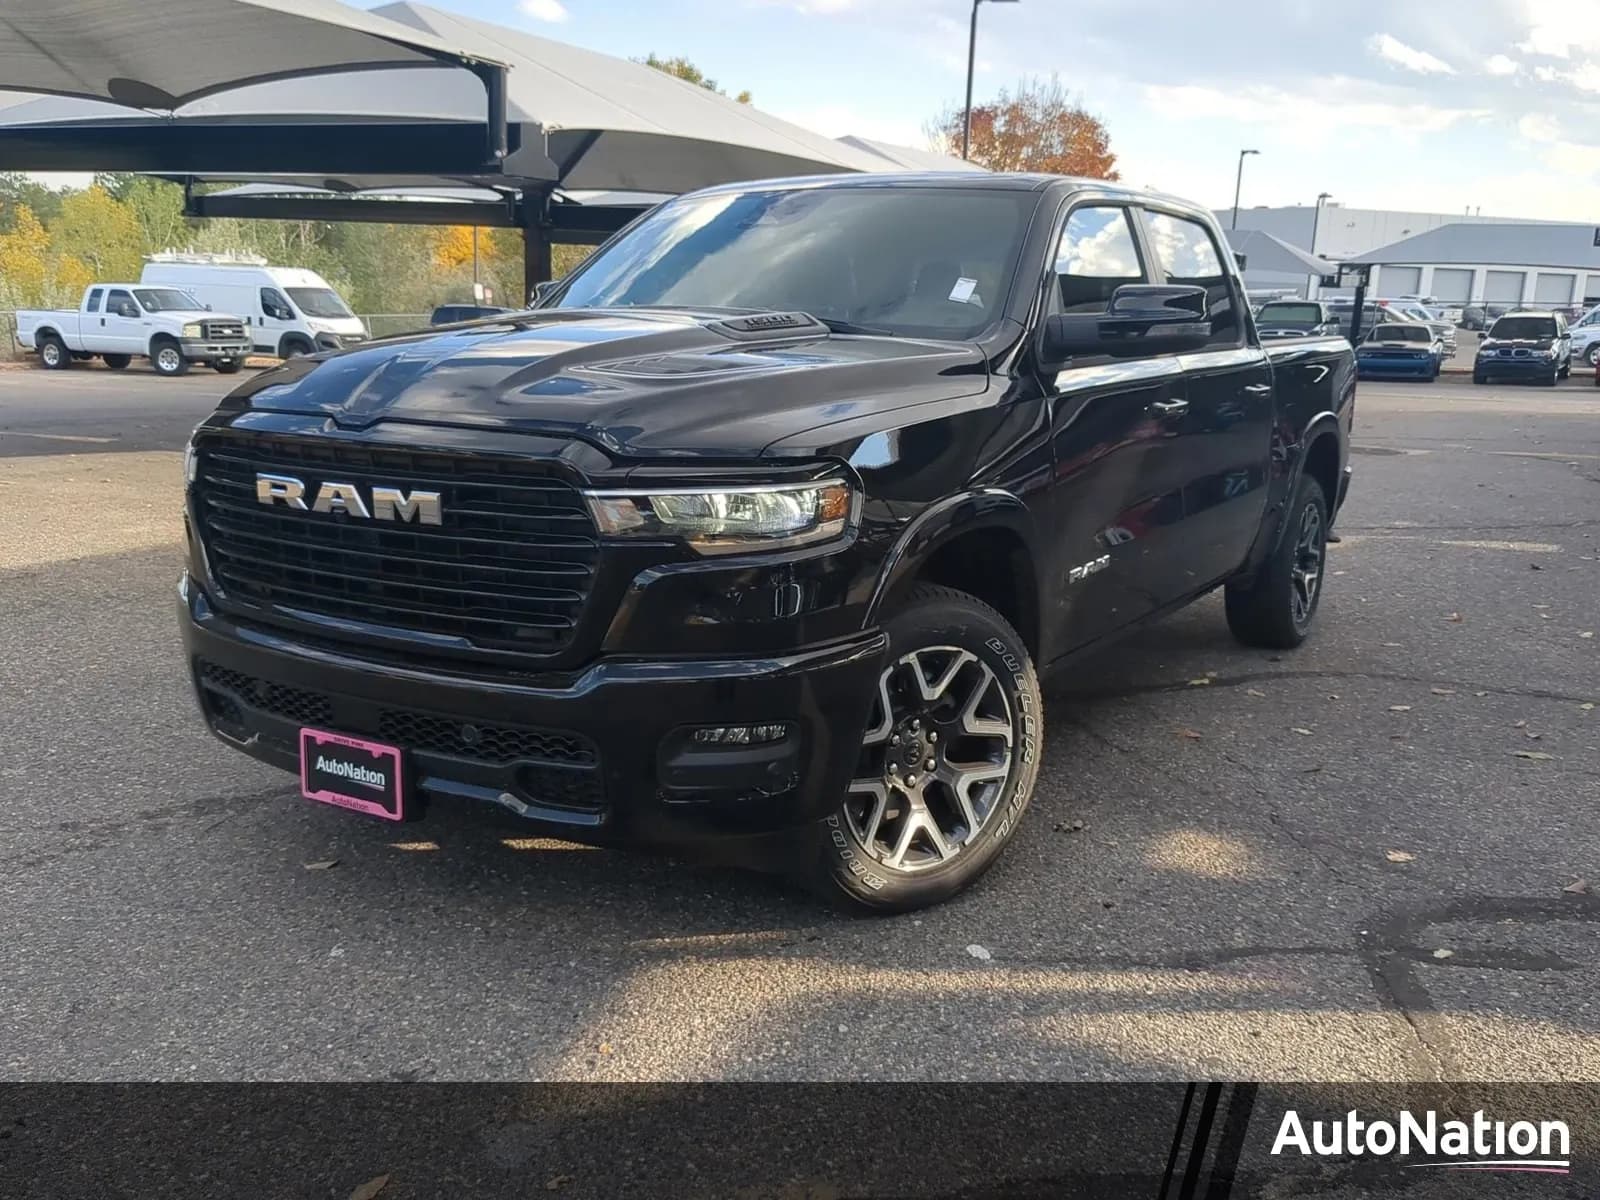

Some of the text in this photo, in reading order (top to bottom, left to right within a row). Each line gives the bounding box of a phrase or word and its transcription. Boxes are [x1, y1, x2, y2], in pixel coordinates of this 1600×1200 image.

[256, 472, 442, 526] RAM
[985, 637, 1035, 765] DUELER
[316, 755, 386, 787] AutoNation
